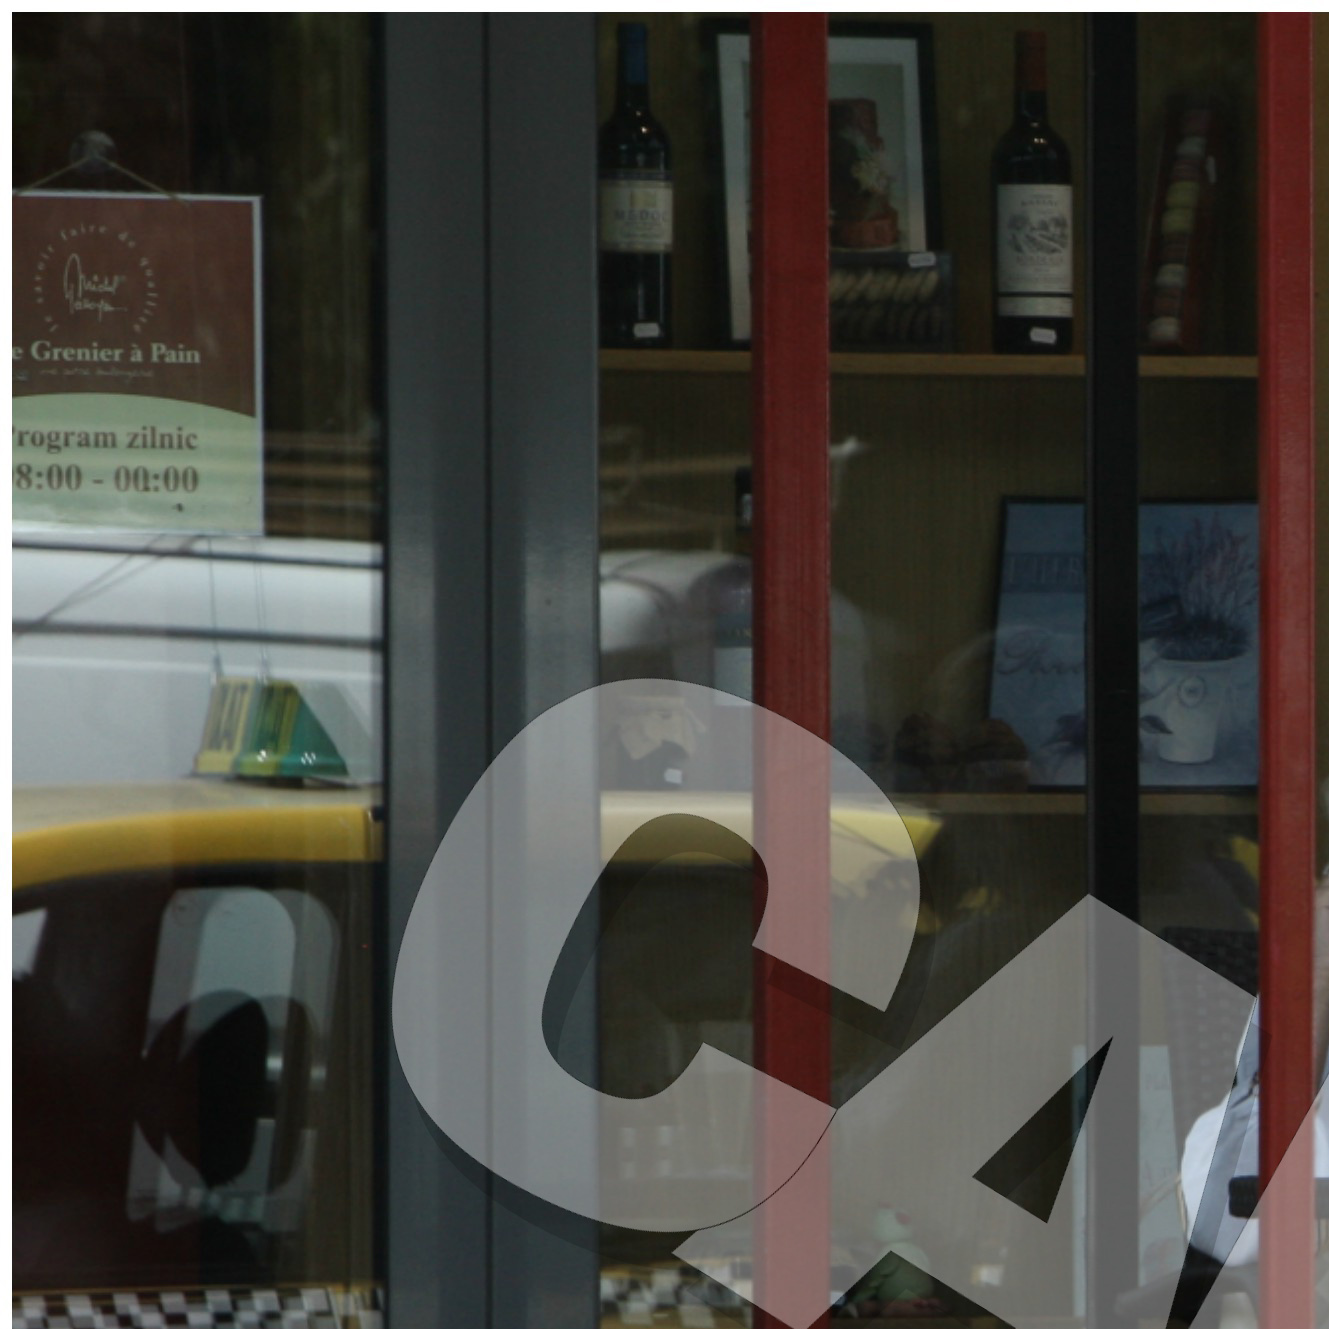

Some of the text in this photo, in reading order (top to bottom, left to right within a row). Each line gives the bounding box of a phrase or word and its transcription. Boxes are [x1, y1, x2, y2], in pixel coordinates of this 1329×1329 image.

[31, 340, 123, 363] Grenier
[130, 344, 144, 363] à
[150, 343, 201, 365] Pain
[12, 426, 199, 454] rogram zilnic
[12, 463, 83, 491] 8:00
[114, 465, 200, 493] 00:00
